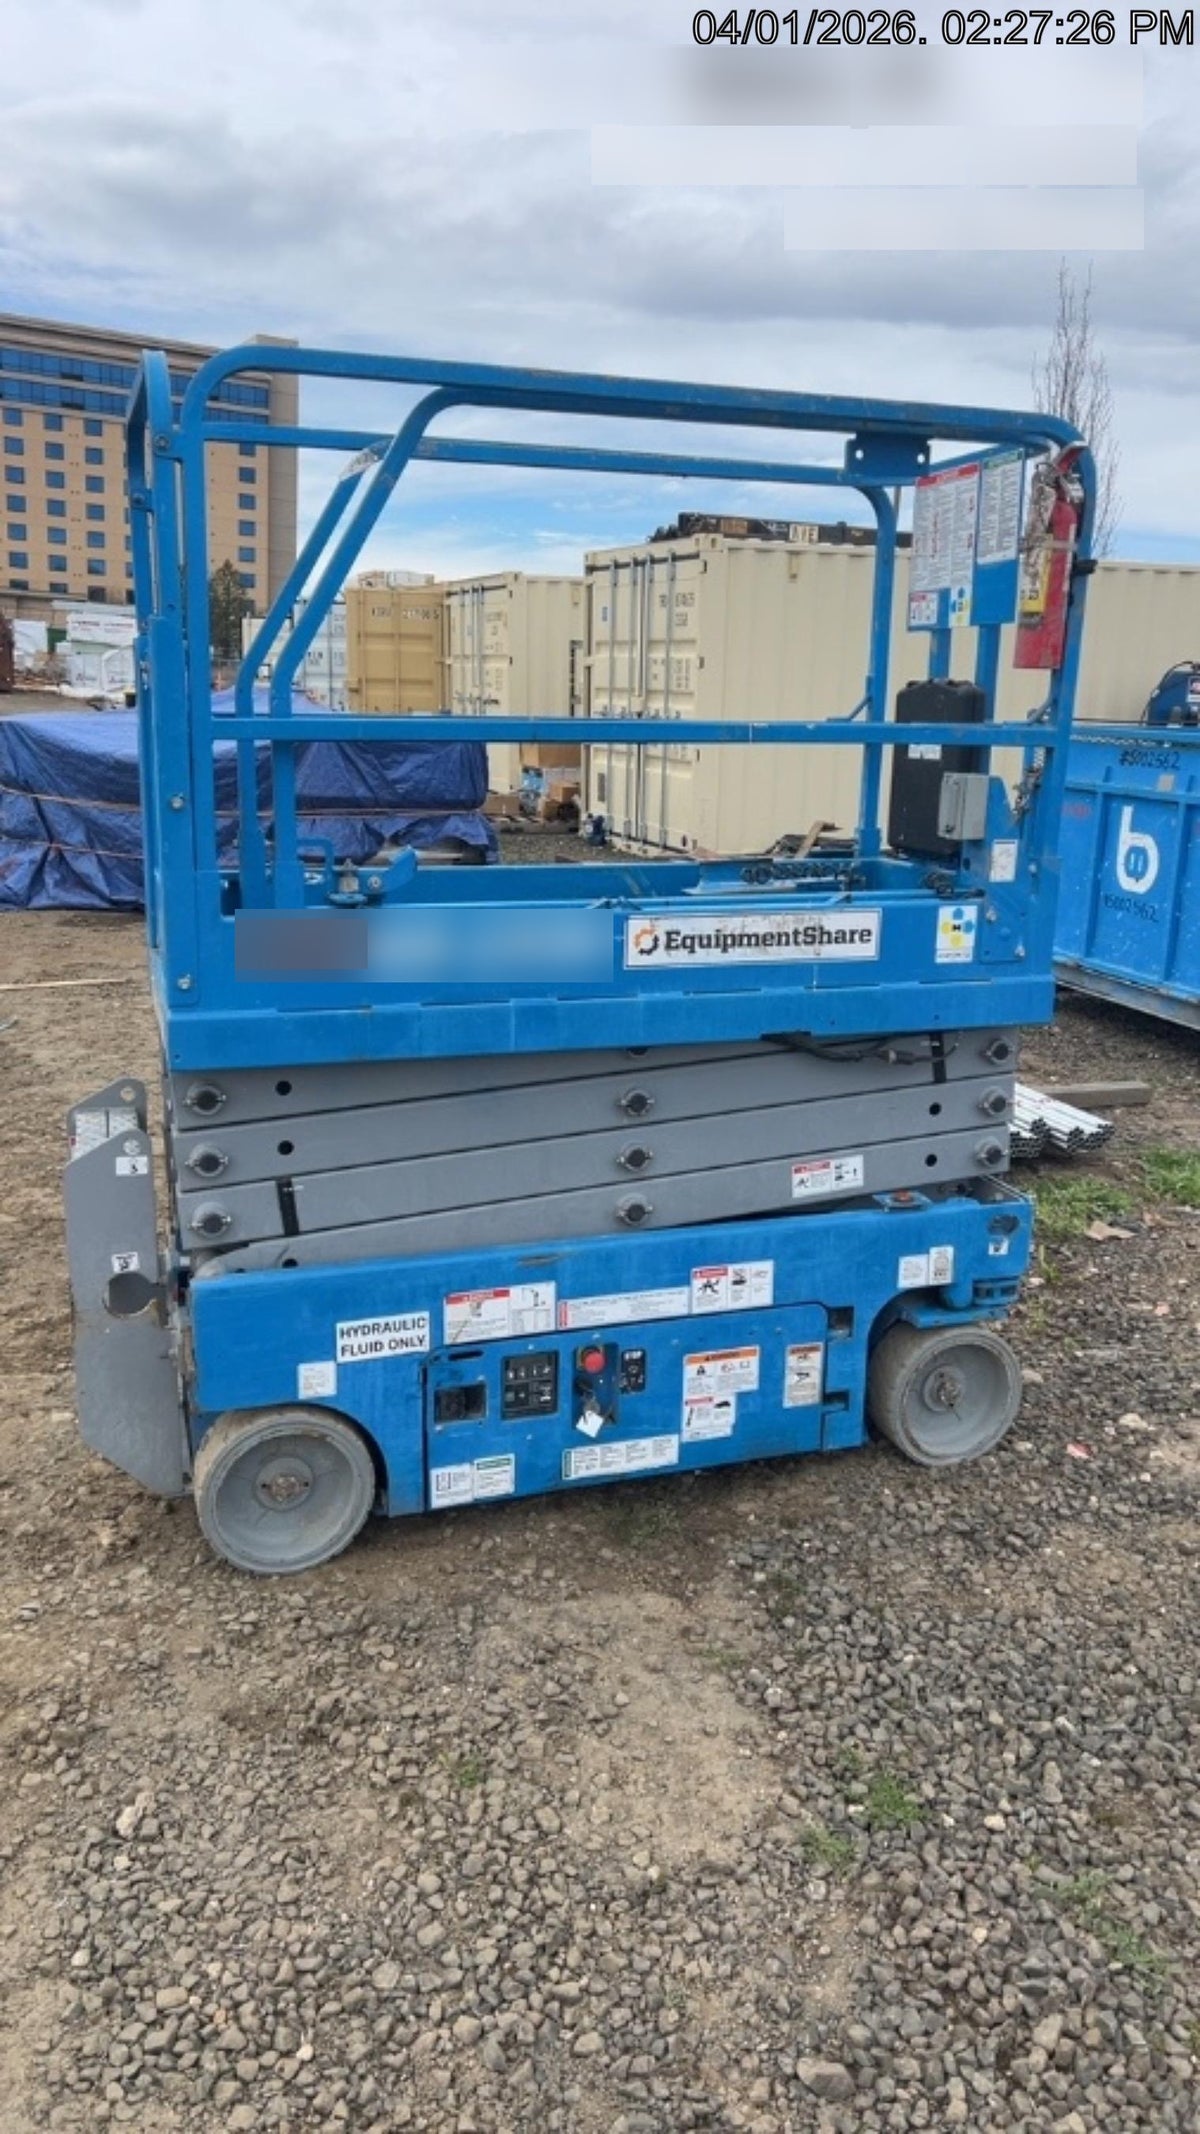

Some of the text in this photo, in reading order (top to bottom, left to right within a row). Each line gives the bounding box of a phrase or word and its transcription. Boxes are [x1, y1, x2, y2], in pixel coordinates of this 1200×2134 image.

[664, 926, 871, 953] EquipmentShare
[339, 1316, 426, 1340] HYDRAULIC
[341, 1334, 426, 1357] FLUID ONLY
